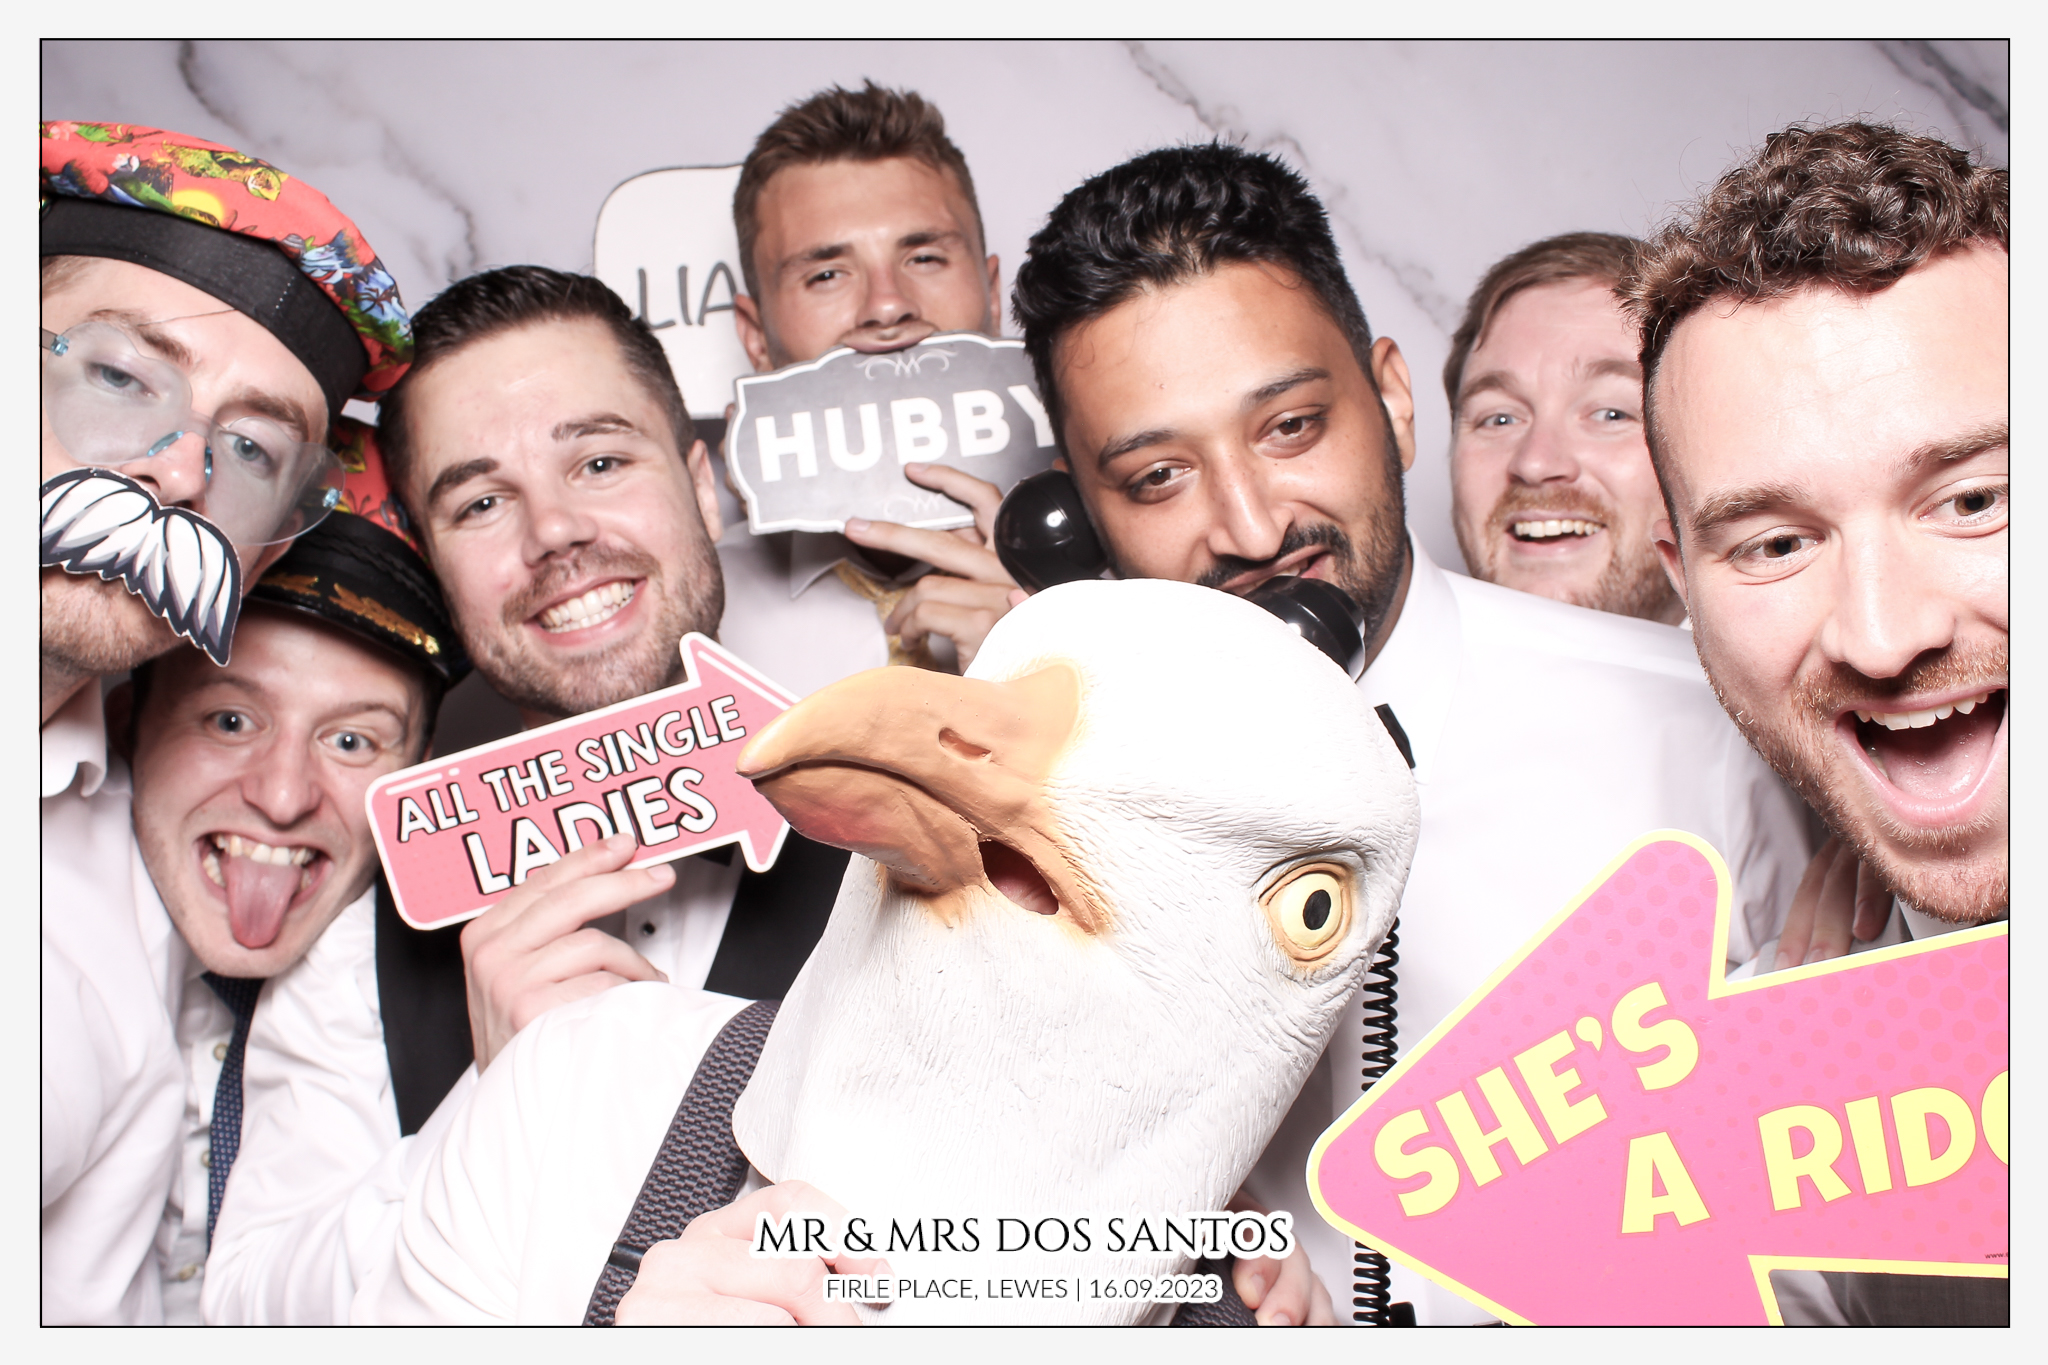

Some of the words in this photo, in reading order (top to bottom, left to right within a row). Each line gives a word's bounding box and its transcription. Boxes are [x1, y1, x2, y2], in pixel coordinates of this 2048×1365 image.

[633, 260, 737, 331] LIA
[755, 384, 1056, 483] HUBBY
[397, 782, 479, 843] ALL
[480, 750, 574, 812] THE
[577, 695, 746, 783] SINGLE
[462, 766, 718, 895] LADIES
[1374, 981, 1699, 1217] SHE'S
[1621, 1131, 1711, 1234] A
